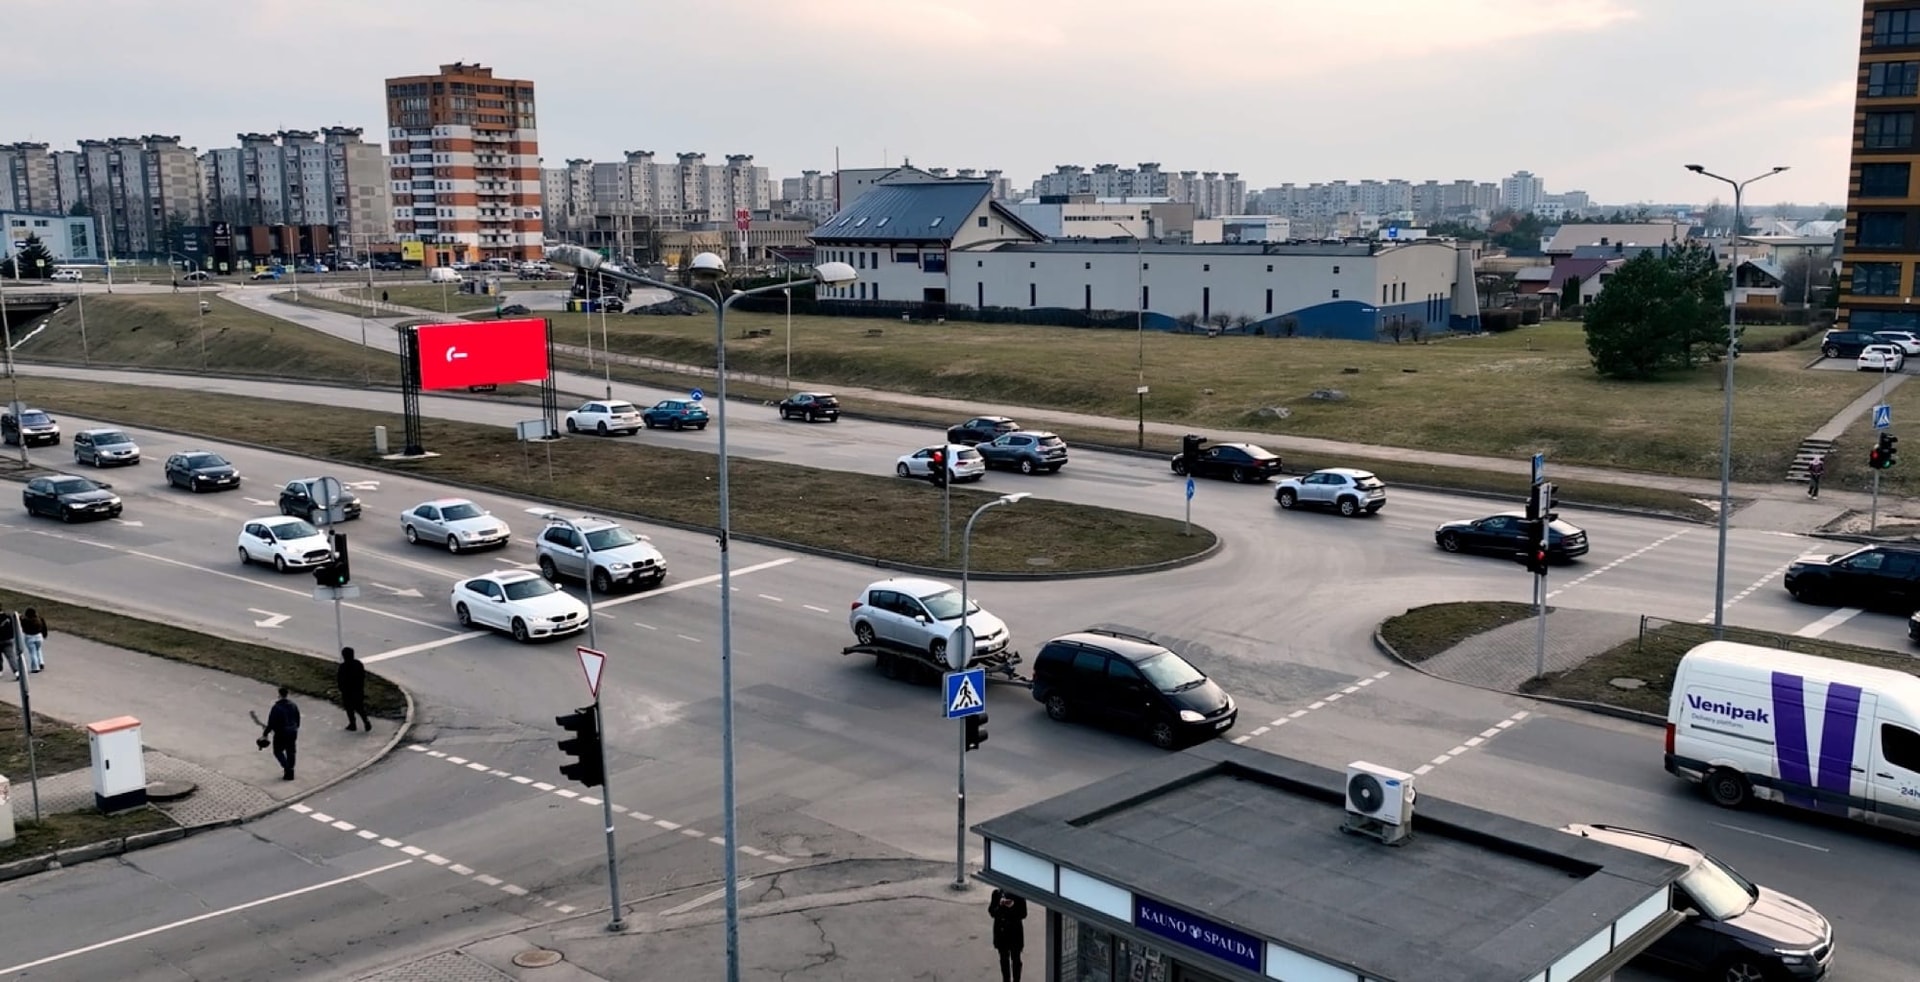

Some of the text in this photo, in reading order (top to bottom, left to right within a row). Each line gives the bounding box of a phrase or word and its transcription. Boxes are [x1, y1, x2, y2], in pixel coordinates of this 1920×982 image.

[1687, 693, 1769, 724] Venipak
[1141, 906, 1255, 960] KAUNO SPAUDA
